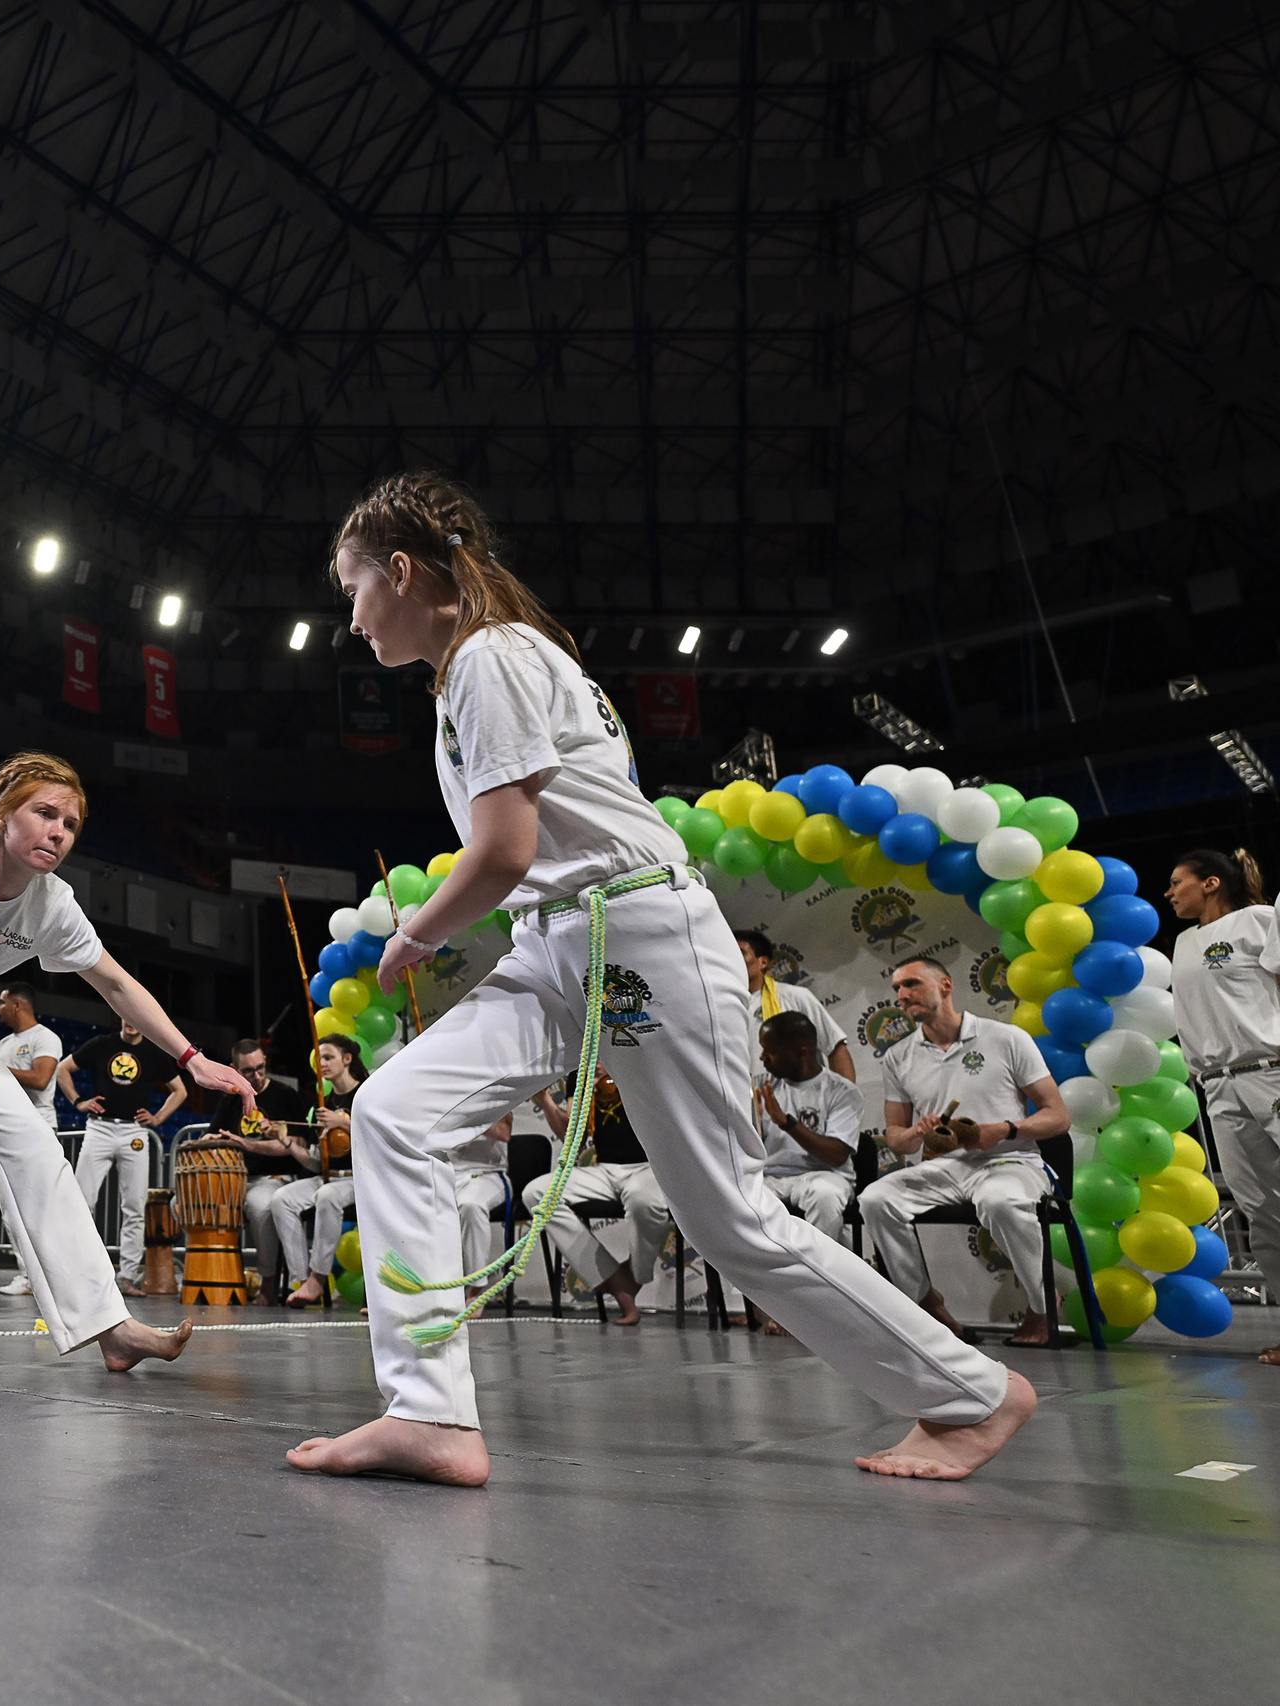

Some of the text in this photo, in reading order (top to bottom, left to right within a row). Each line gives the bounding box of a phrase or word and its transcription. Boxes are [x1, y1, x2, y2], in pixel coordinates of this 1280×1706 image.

[154, 673, 166, 701] 5
[870, 886, 885, 896] DE
[887, 886, 916, 906] OURO
[625, 970, 652, 1001] OURO
[877, 999, 891, 1009] DE
